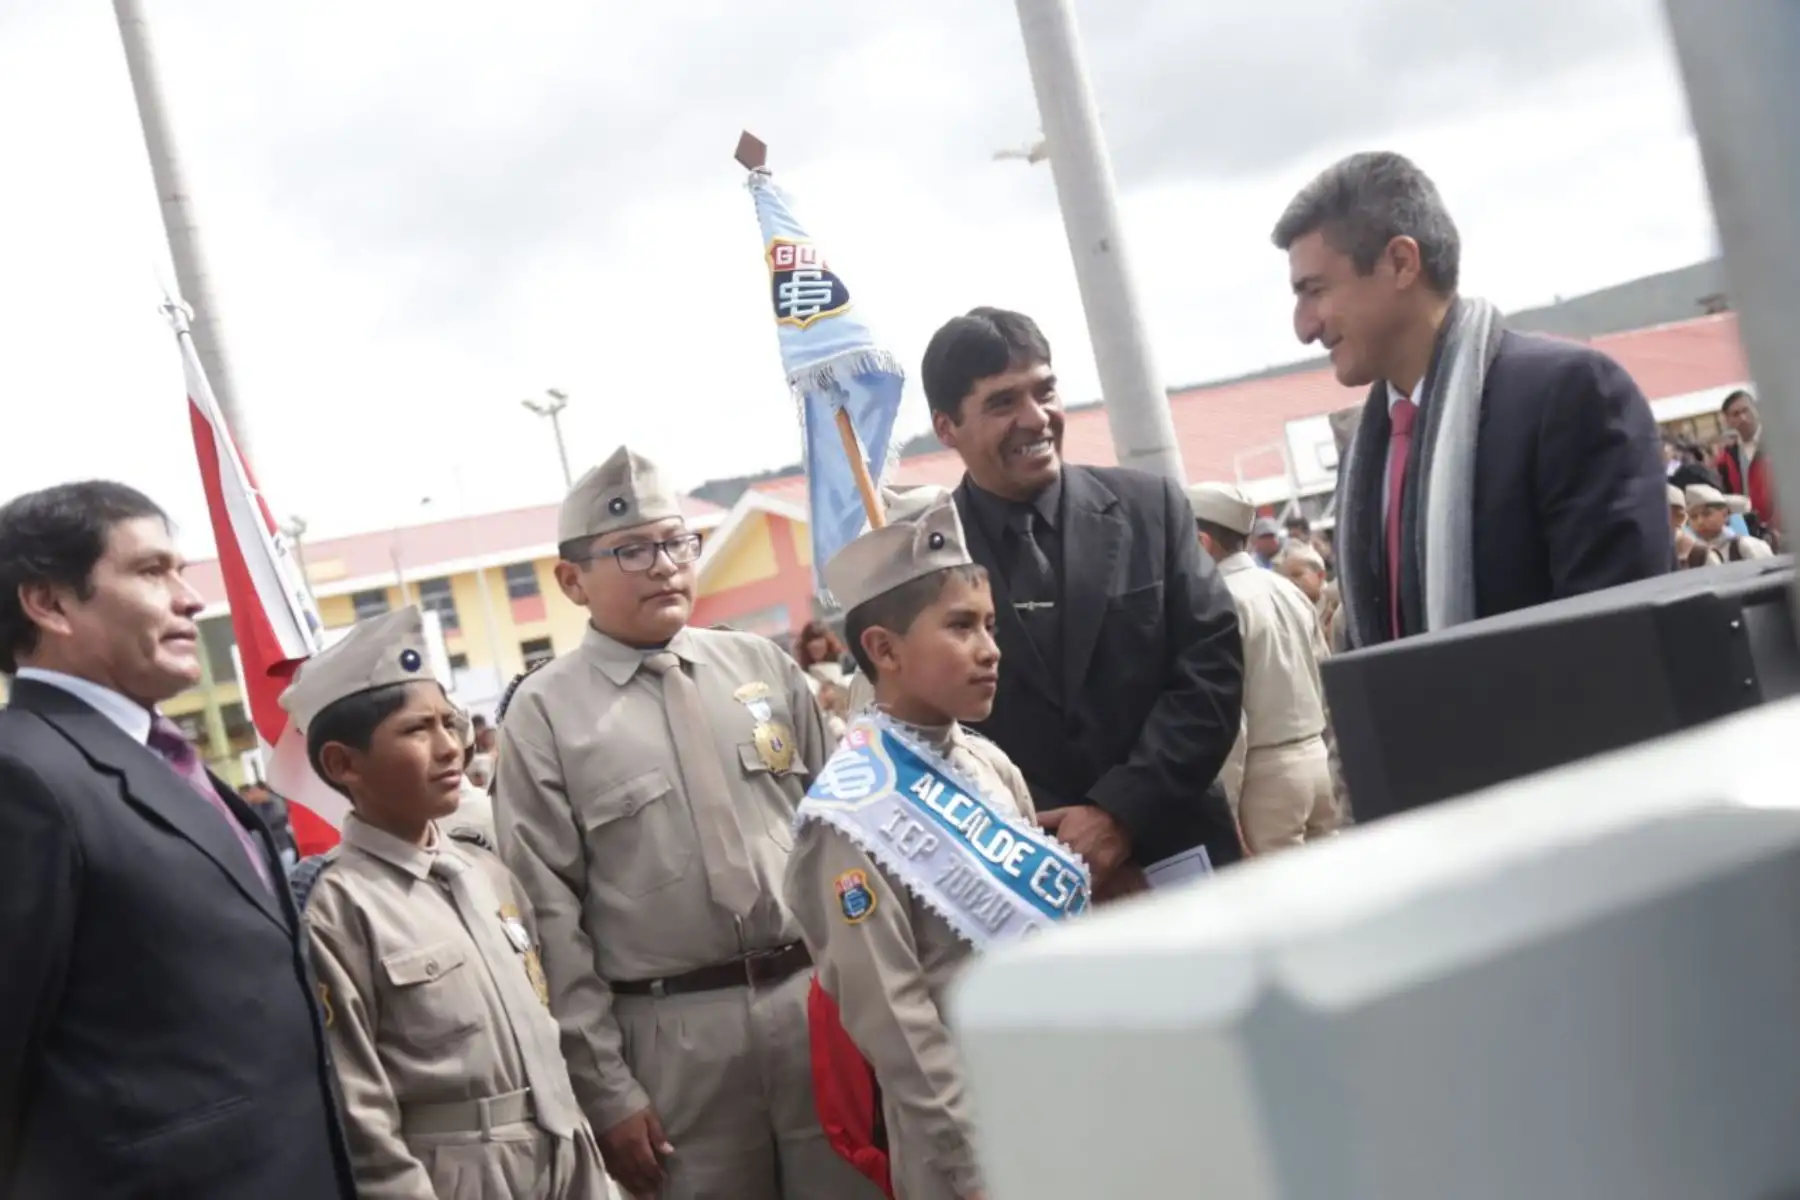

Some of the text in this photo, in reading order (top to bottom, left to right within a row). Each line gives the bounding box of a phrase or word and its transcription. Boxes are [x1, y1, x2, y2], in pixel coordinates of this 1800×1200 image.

[775, 245, 828, 268] GU
[880, 806, 939, 859] IEP
[910, 772, 1036, 878] ALCALDE
[1030, 856, 1088, 918] ESC
